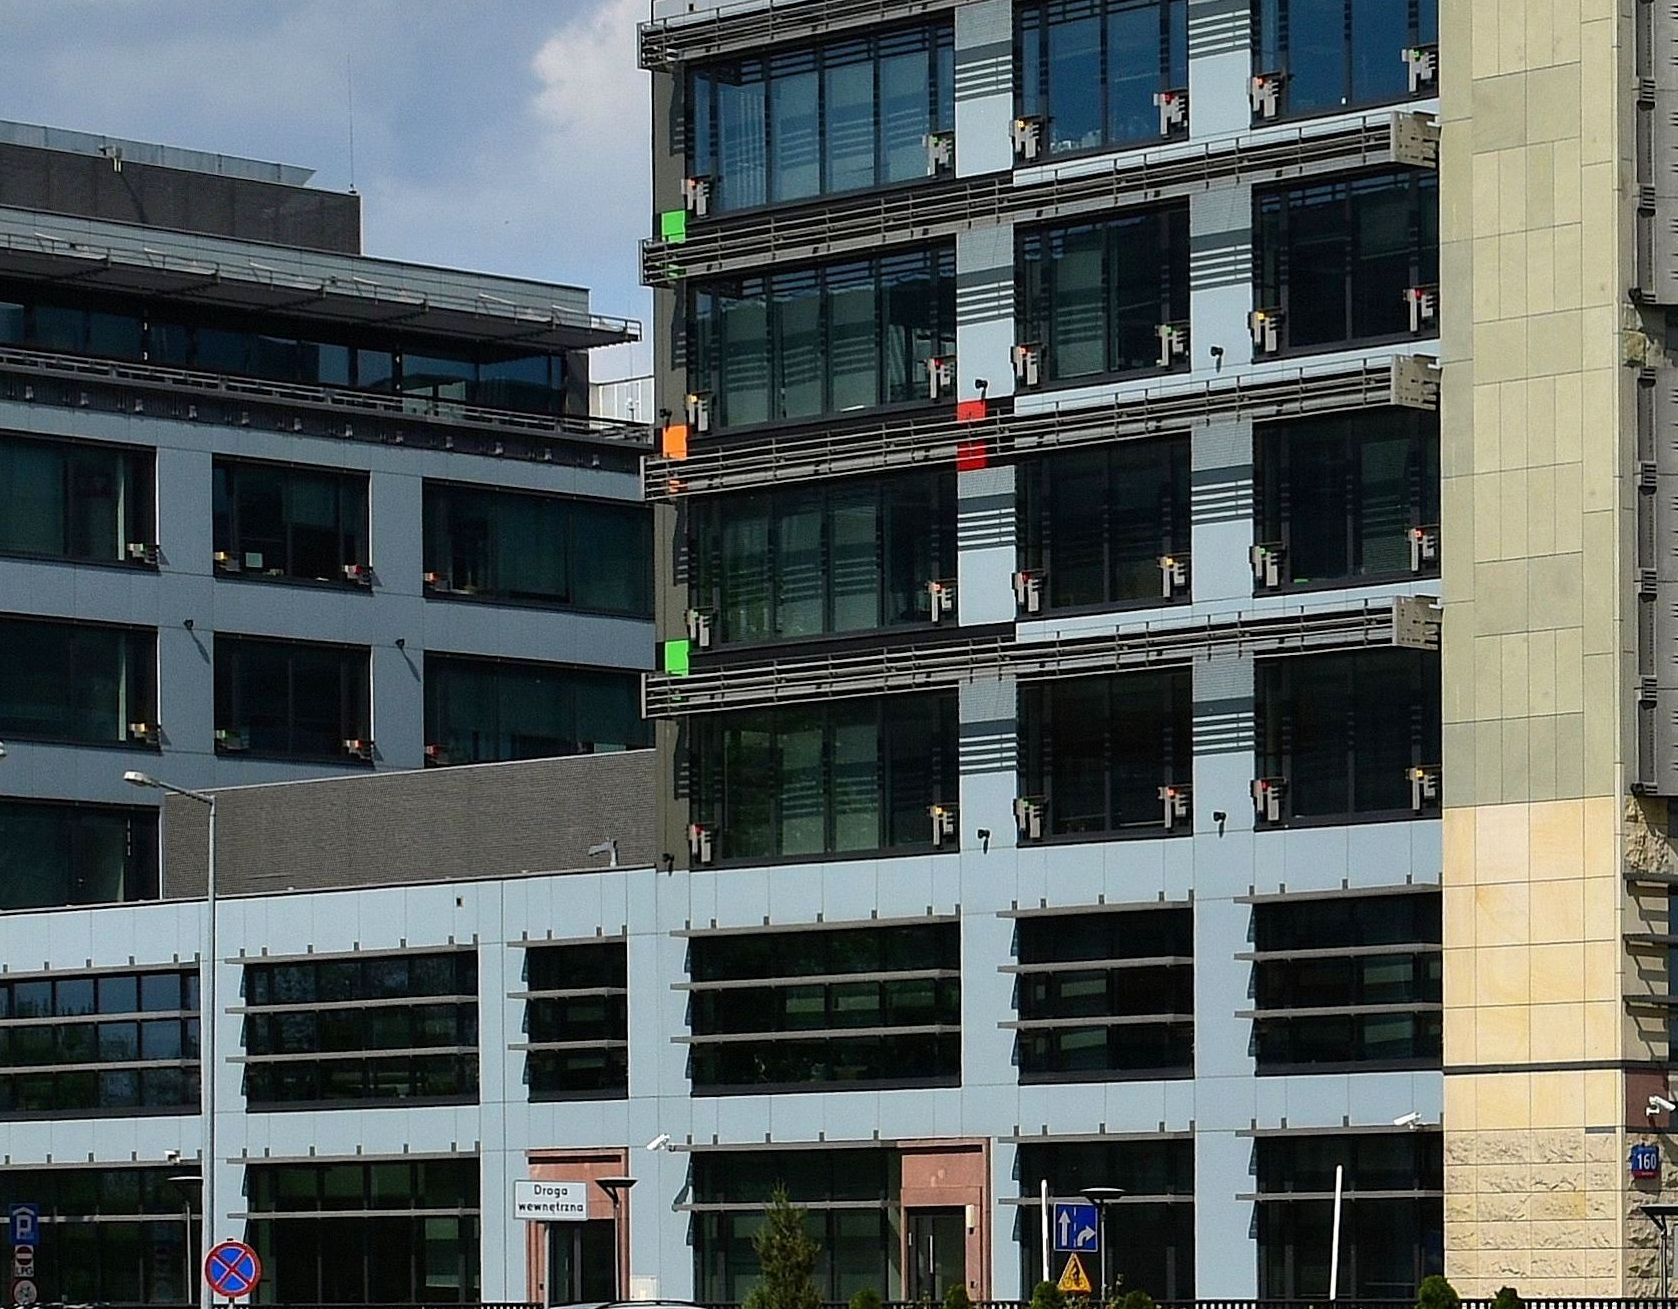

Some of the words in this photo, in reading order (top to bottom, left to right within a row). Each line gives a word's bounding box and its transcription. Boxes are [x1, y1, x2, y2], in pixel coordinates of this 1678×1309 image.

[1637, 1153, 1657, 1170] 160
[533, 1184, 568, 1198] Droga
[518, 1202, 584, 1214] wewnętrzna
[15, 1266, 34, 1276] LPG
